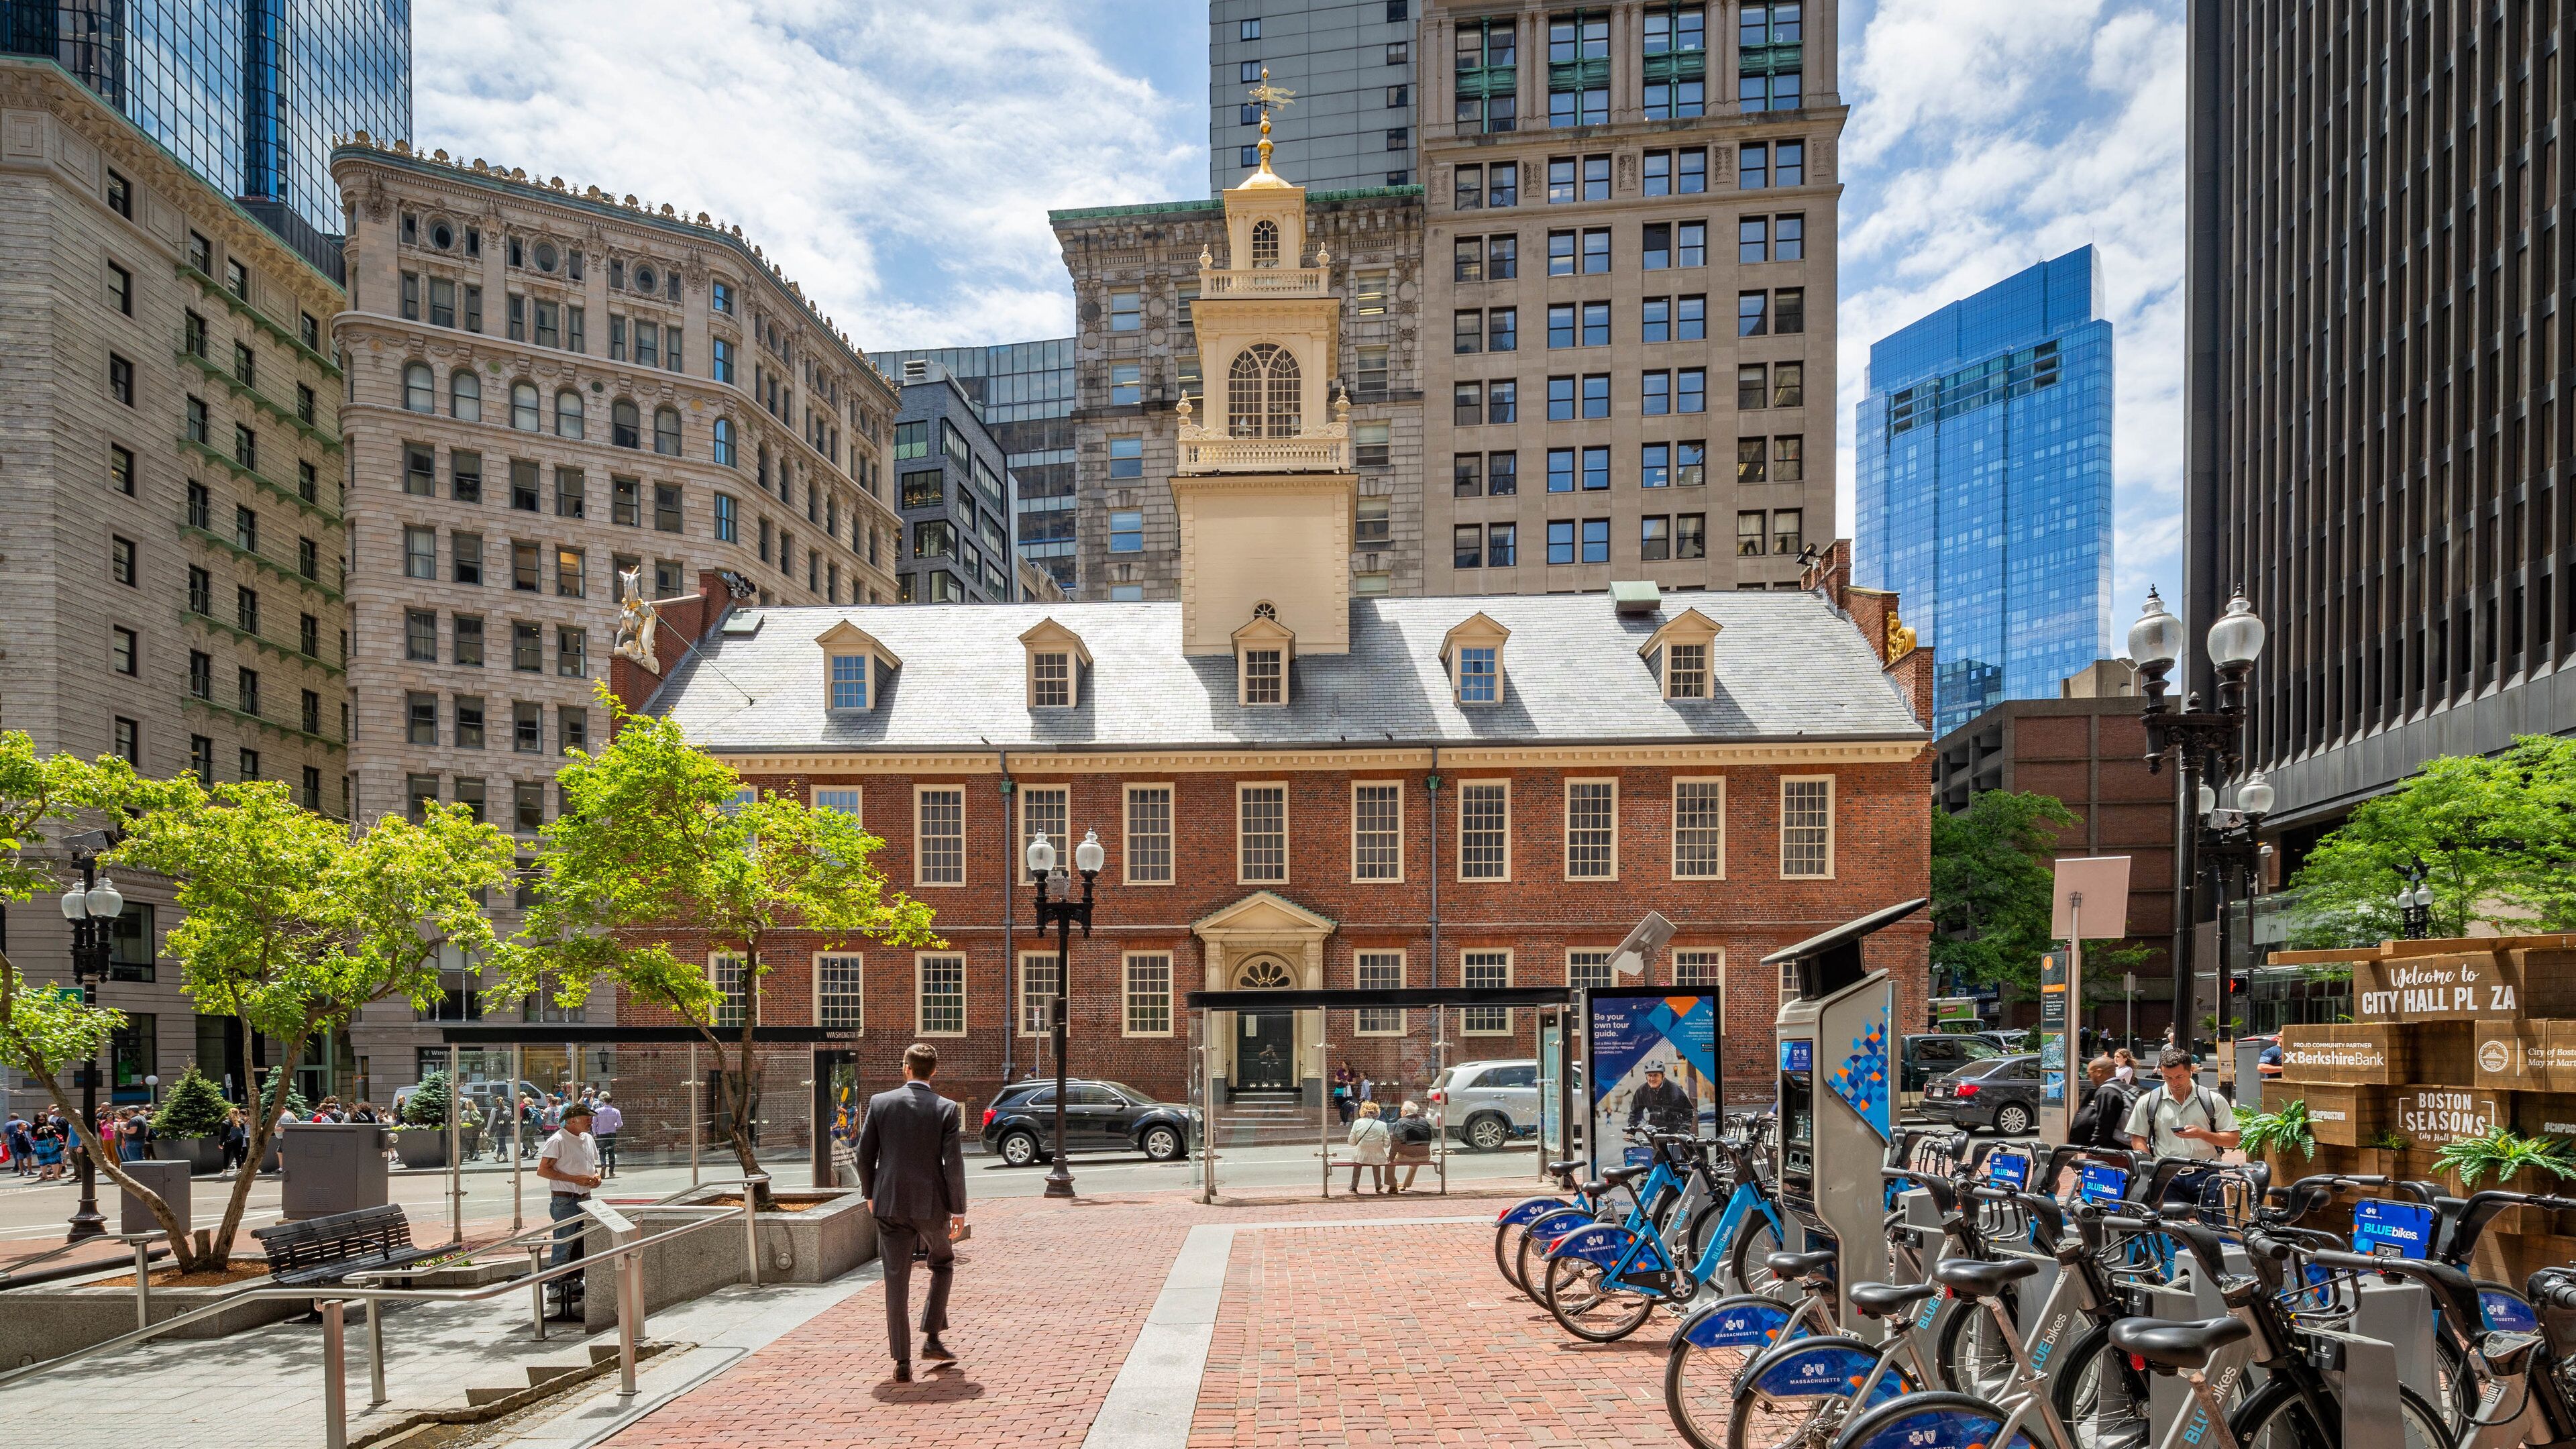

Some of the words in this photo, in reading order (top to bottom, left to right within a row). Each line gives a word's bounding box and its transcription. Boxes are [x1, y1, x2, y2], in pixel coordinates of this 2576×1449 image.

[2390, 965, 2455, 988] Welcome
[2461, 963, 2479, 982] to
[2362, 991, 2399, 1014] CITY
[2404, 987, 2449, 1012] HALL
[1595, 1030, 1619, 1038] guide.
[2528, 1048, 2544, 1057] City
[2547, 1048, 2555, 1057] of
[2528, 1059, 2555, 1068] Mayor
[2418, 1092, 2471, 1110] BOSTON
[2308, 1110, 2346, 1121] #CHPBOSTON
[2406, 1110, 2486, 1136] SEASONS
[2419, 1132, 2430, 1142] City
[2433, 1132, 2449, 1142] Hall
[2451, 1133, 2467, 1144] Pla
[1994, 1167, 2019, 1177] BLUEbikes
[2087, 1181, 2117, 1195] BLUEbikes
[1672, 1194, 1696, 1230] BLUEbikes
[2363, 1222, 2418, 1240] BLUEbikes
[1578, 1244, 1616, 1252] MASSACHUSETTS
[1711, 1225, 1733, 1260] BLUEbikes
[1917, 1283, 1945, 1330] BLUEbik
[2031, 1313, 2067, 1370] LUEbikes
